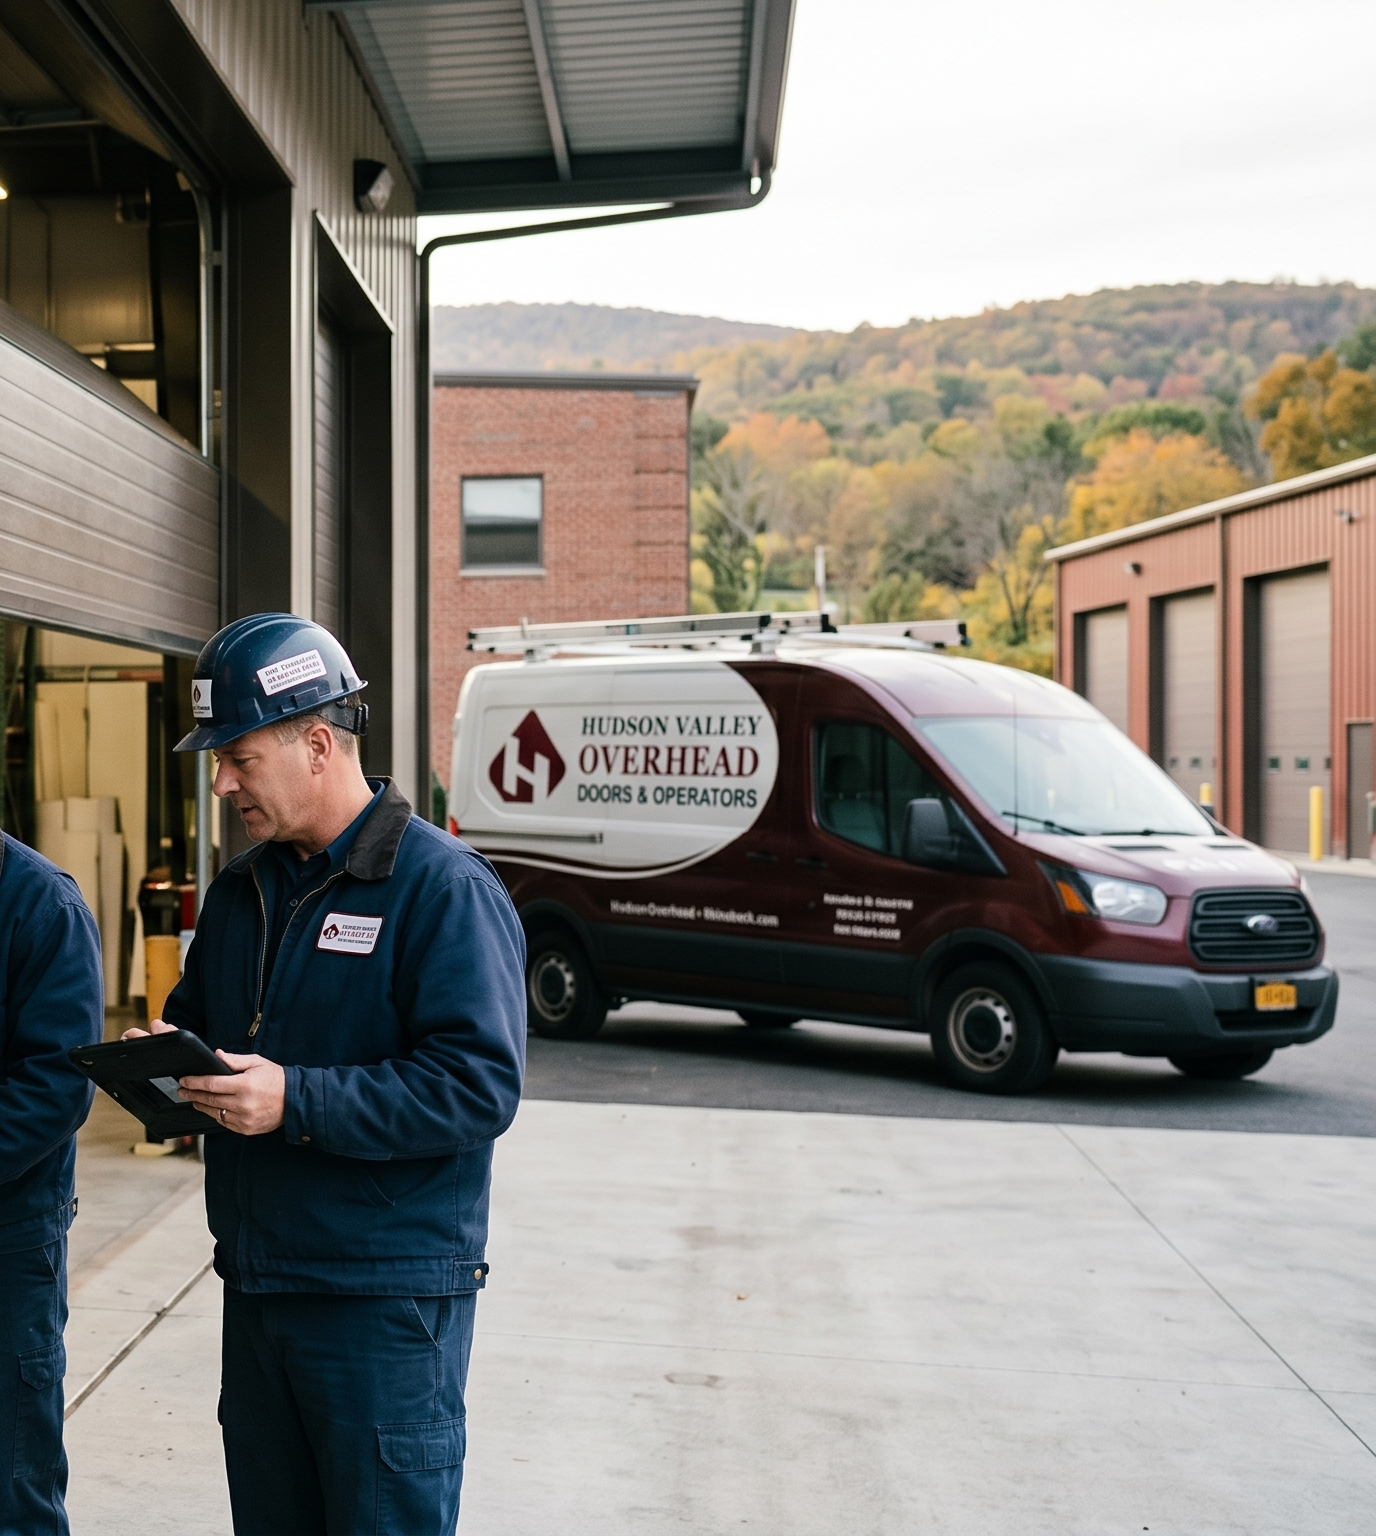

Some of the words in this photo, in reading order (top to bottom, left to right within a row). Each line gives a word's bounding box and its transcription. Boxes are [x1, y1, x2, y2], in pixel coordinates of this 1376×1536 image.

[581, 716, 669, 736] HUDSON
[676, 716, 762, 736] VALLEY
[579, 744, 759, 778] OVERHEAD
[578, 784, 632, 804] DOORS
[637, 786, 648, 804] &
[653, 786, 758, 808] OPERATORS
